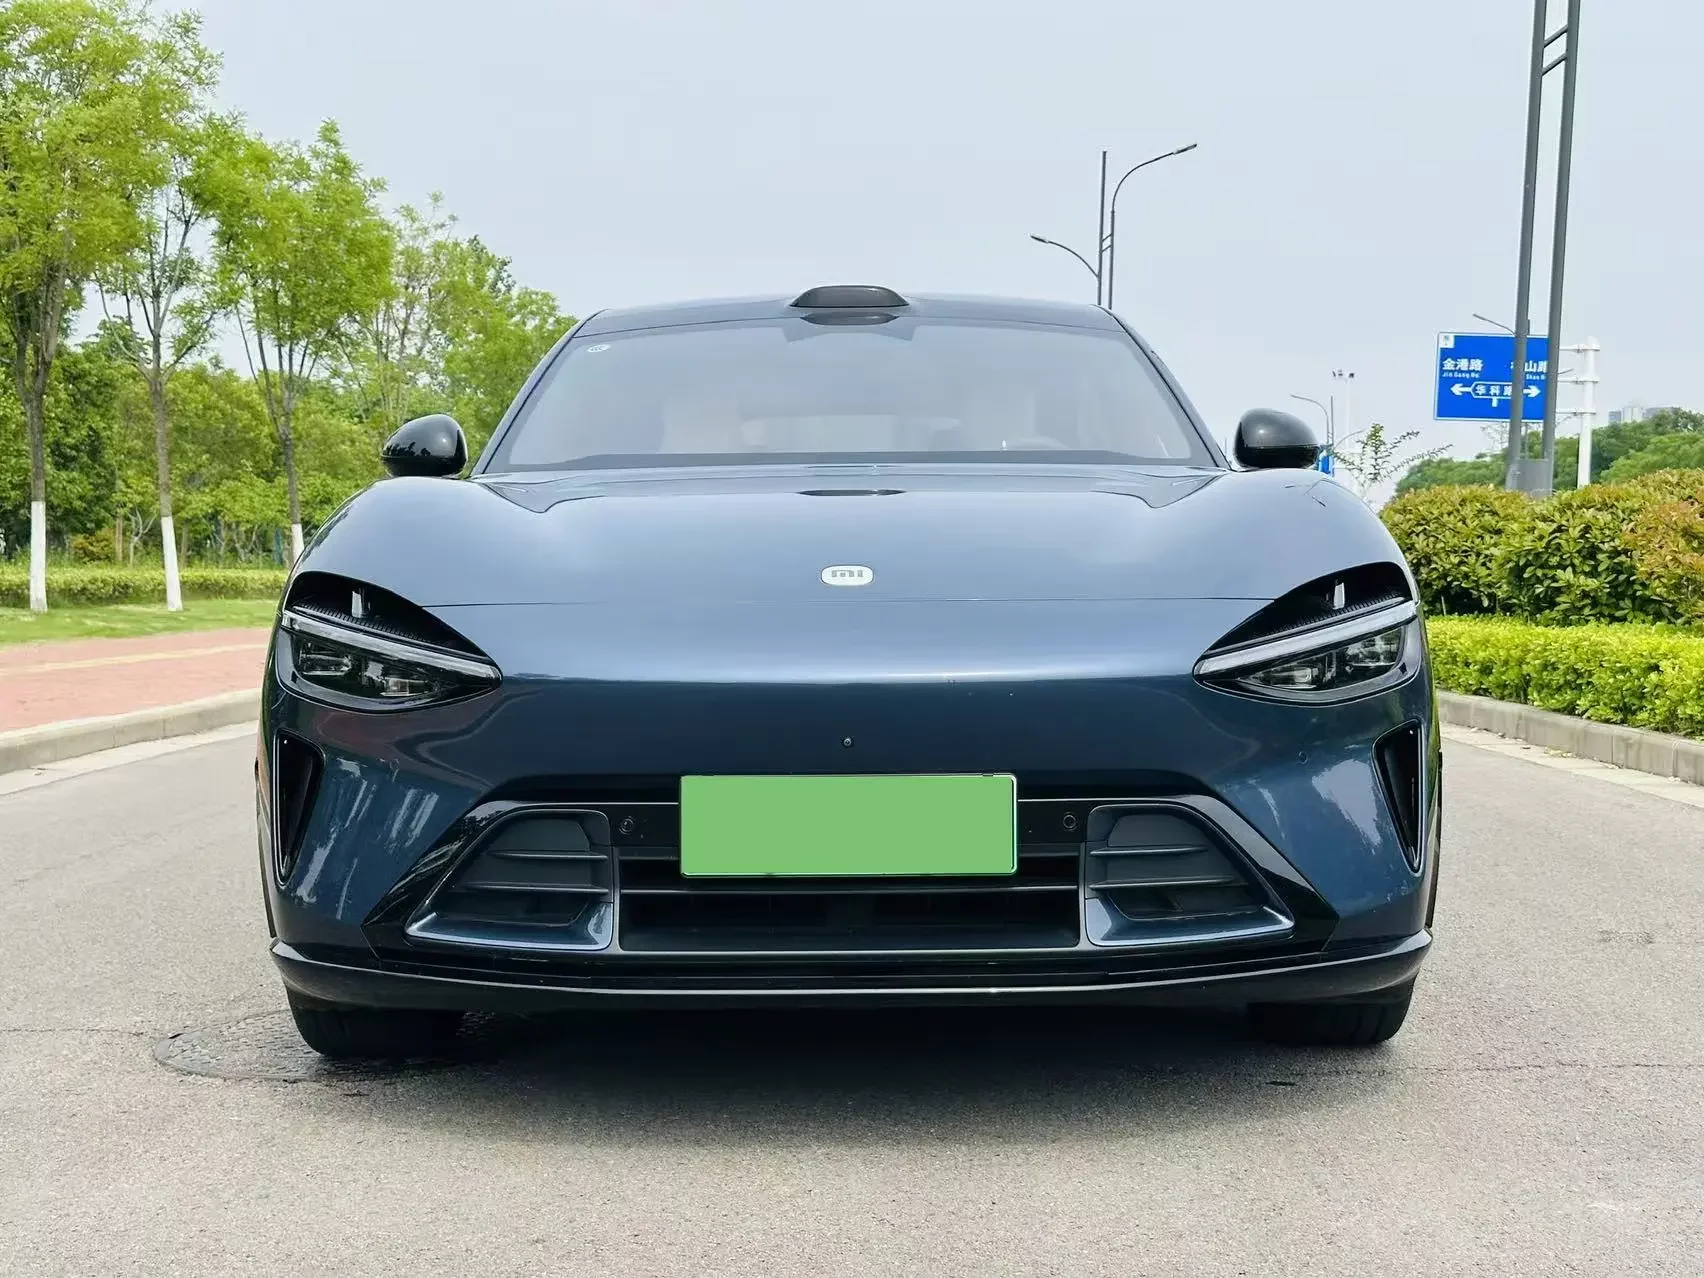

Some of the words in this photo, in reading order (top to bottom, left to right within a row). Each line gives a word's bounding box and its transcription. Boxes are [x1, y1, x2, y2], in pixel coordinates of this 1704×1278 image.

[1442, 358, 1484, 371] 金港路
[1510, 360, 1548, 373] 山路
